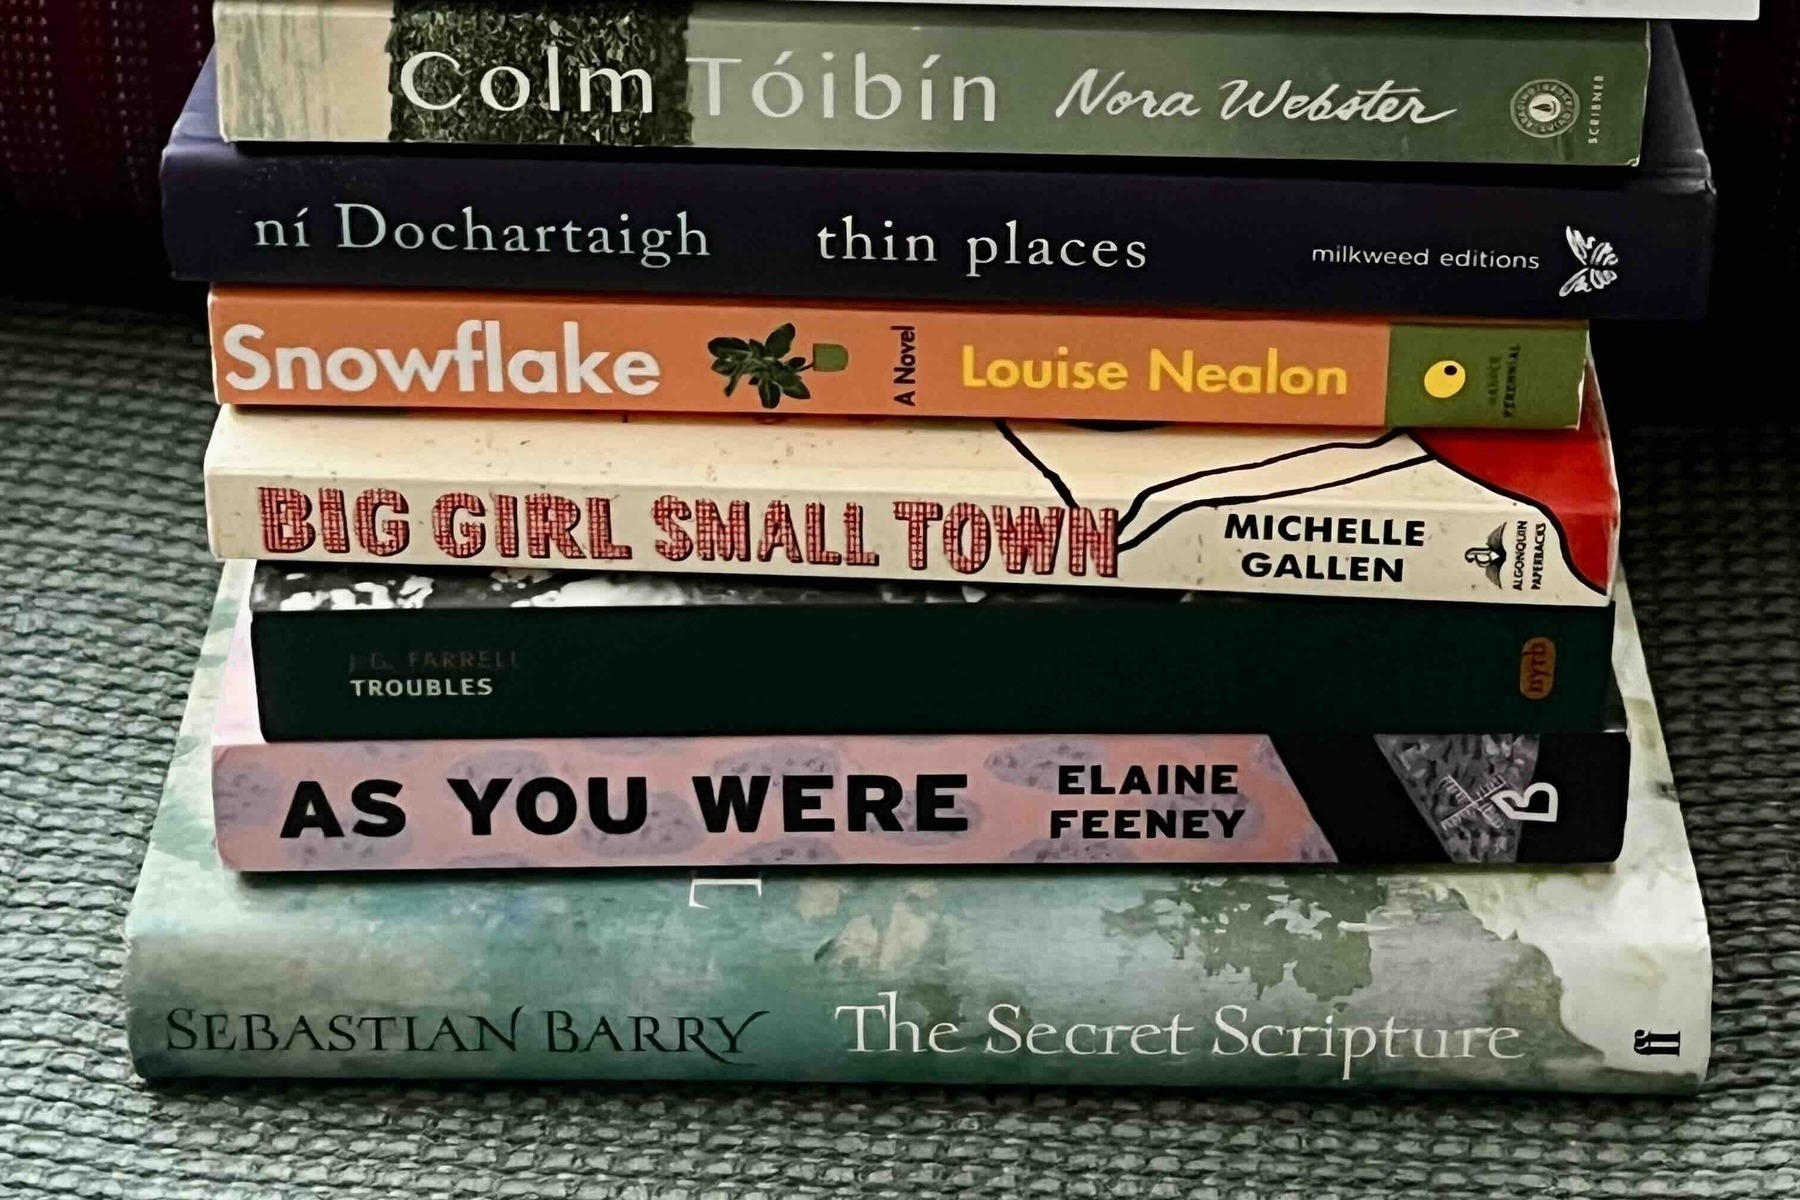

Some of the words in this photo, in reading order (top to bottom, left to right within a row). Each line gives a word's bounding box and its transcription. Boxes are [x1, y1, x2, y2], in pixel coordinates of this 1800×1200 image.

[401, 46, 652, 114] Colm
[686, 53, 996, 122] Tóibín
[1055, 68, 1200, 119] Nora
[1219, 78, 1456, 125] Webster
[254, 207, 310, 248] ní
[335, 203, 710, 268] Dochartaigh
[817, 216, 936, 261] thin
[966, 220, 1146, 276] places
[1311, 244, 1430, 268] milkweed
[1439, 246, 1540, 271] editions
[223, 320, 661, 395] Snowflake
[890, 325, 915, 384] Novel
[961, 345, 1128, 391] Louise
[1149, 348, 1347, 395] Nealon
[893, 390, 915, 407] A
[257, 486, 410, 557] BIG
[432, 491, 632, 560] GIRL
[653, 494, 879, 566] SMALL
[893, 501, 1119, 578] TOWN
[1224, 514, 1425, 547] MICHELLE
[1512, 520, 1528, 591] ALGONQUIN
[1240, 552, 1402, 583] GALLEN
[349, 678, 493, 697] TROUBLES
[280, 779, 403, 838] AS
[447, 776, 648, 836] YOU
[692, 773, 968, 833] WERE
[1057, 764, 1238, 795] ELAINE
[1049, 809, 1247, 839] FEENEY
[166, 1005, 525, 1053] SEBASTIAN
[546, 1010, 770, 1066] BARRY
[835, 990, 960, 1057] The
[984, 1003, 1194, 1057] Secret
[1212, 1004, 1525, 1080] Scripture
